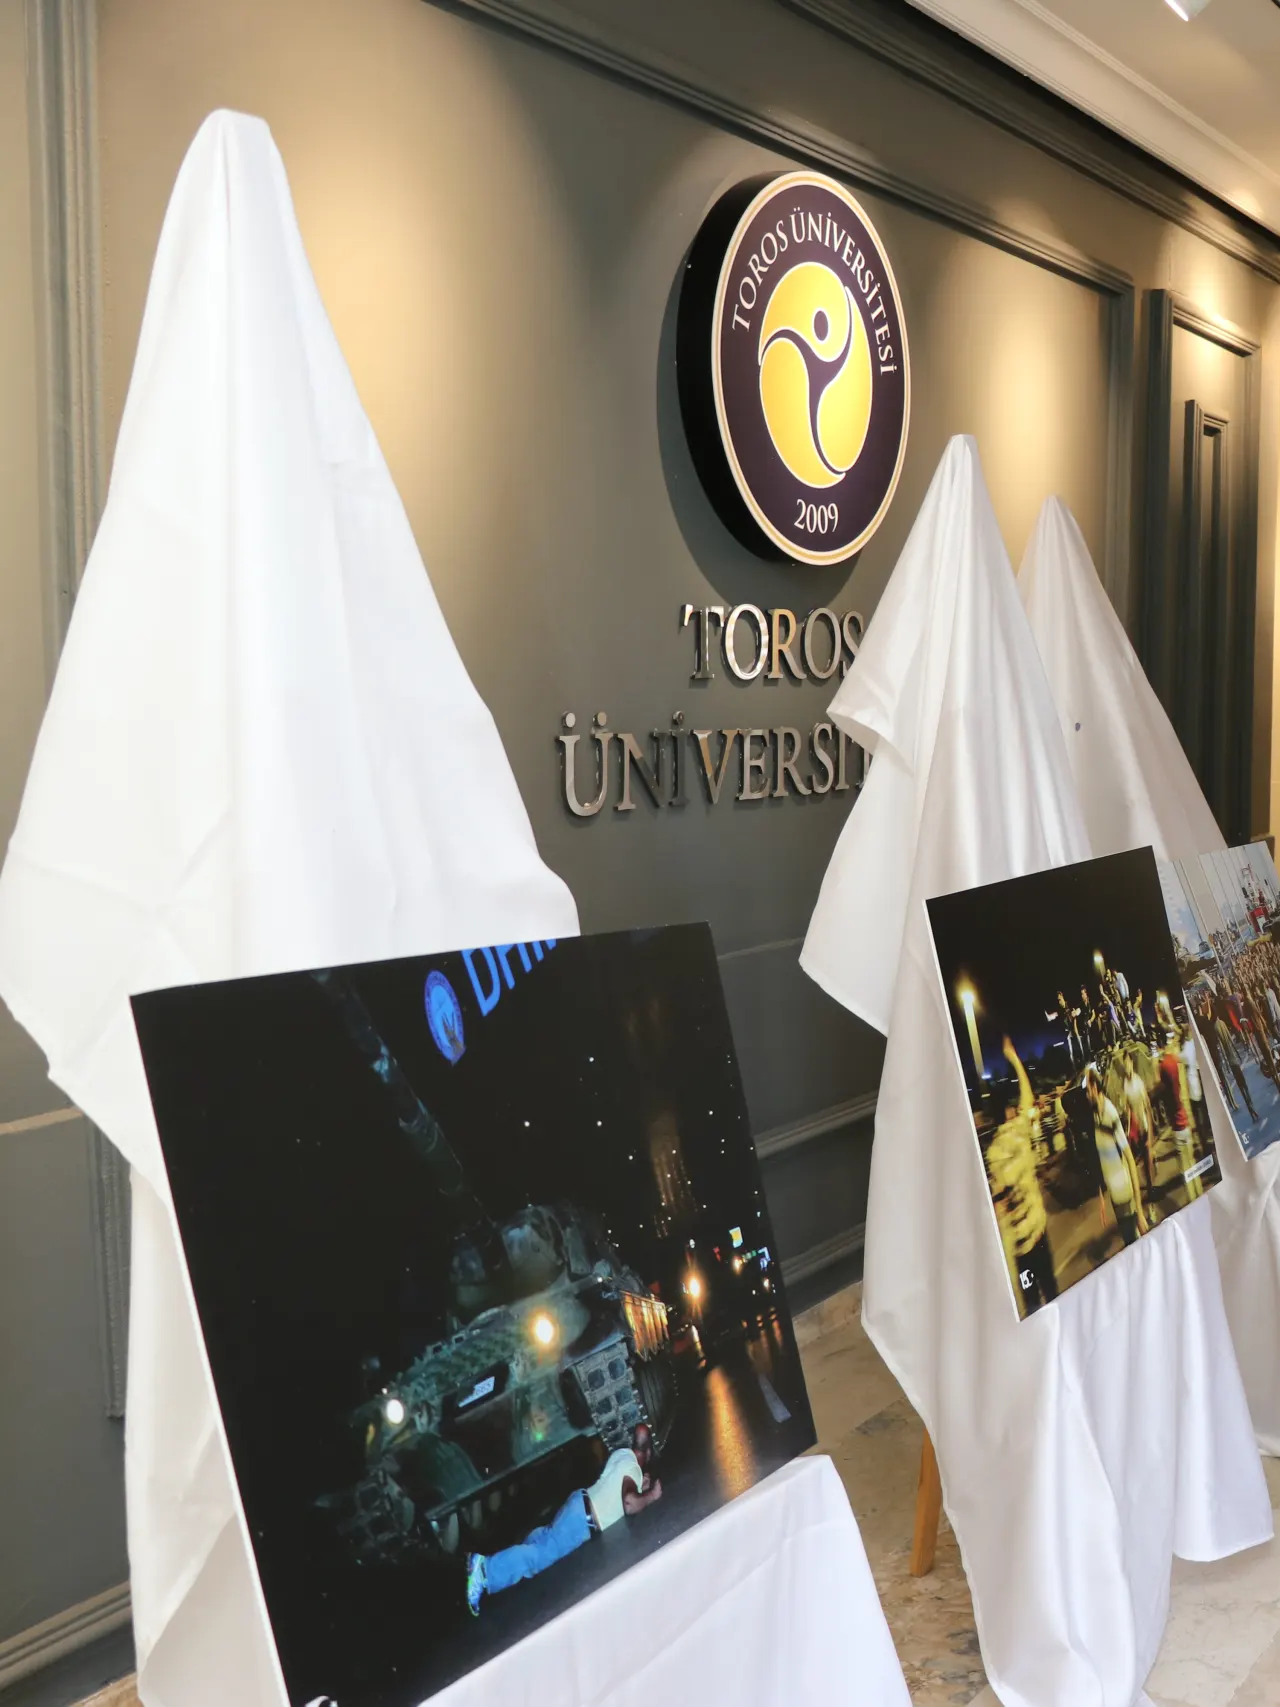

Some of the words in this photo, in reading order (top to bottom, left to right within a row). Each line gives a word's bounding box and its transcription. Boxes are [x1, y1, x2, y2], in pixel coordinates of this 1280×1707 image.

[731, 219, 789, 334] TOROS
[790, 206, 898, 376] ÜNİVERSİTESİ
[794, 498, 839, 535] 2009
[681, 602, 864, 681] TOROS
